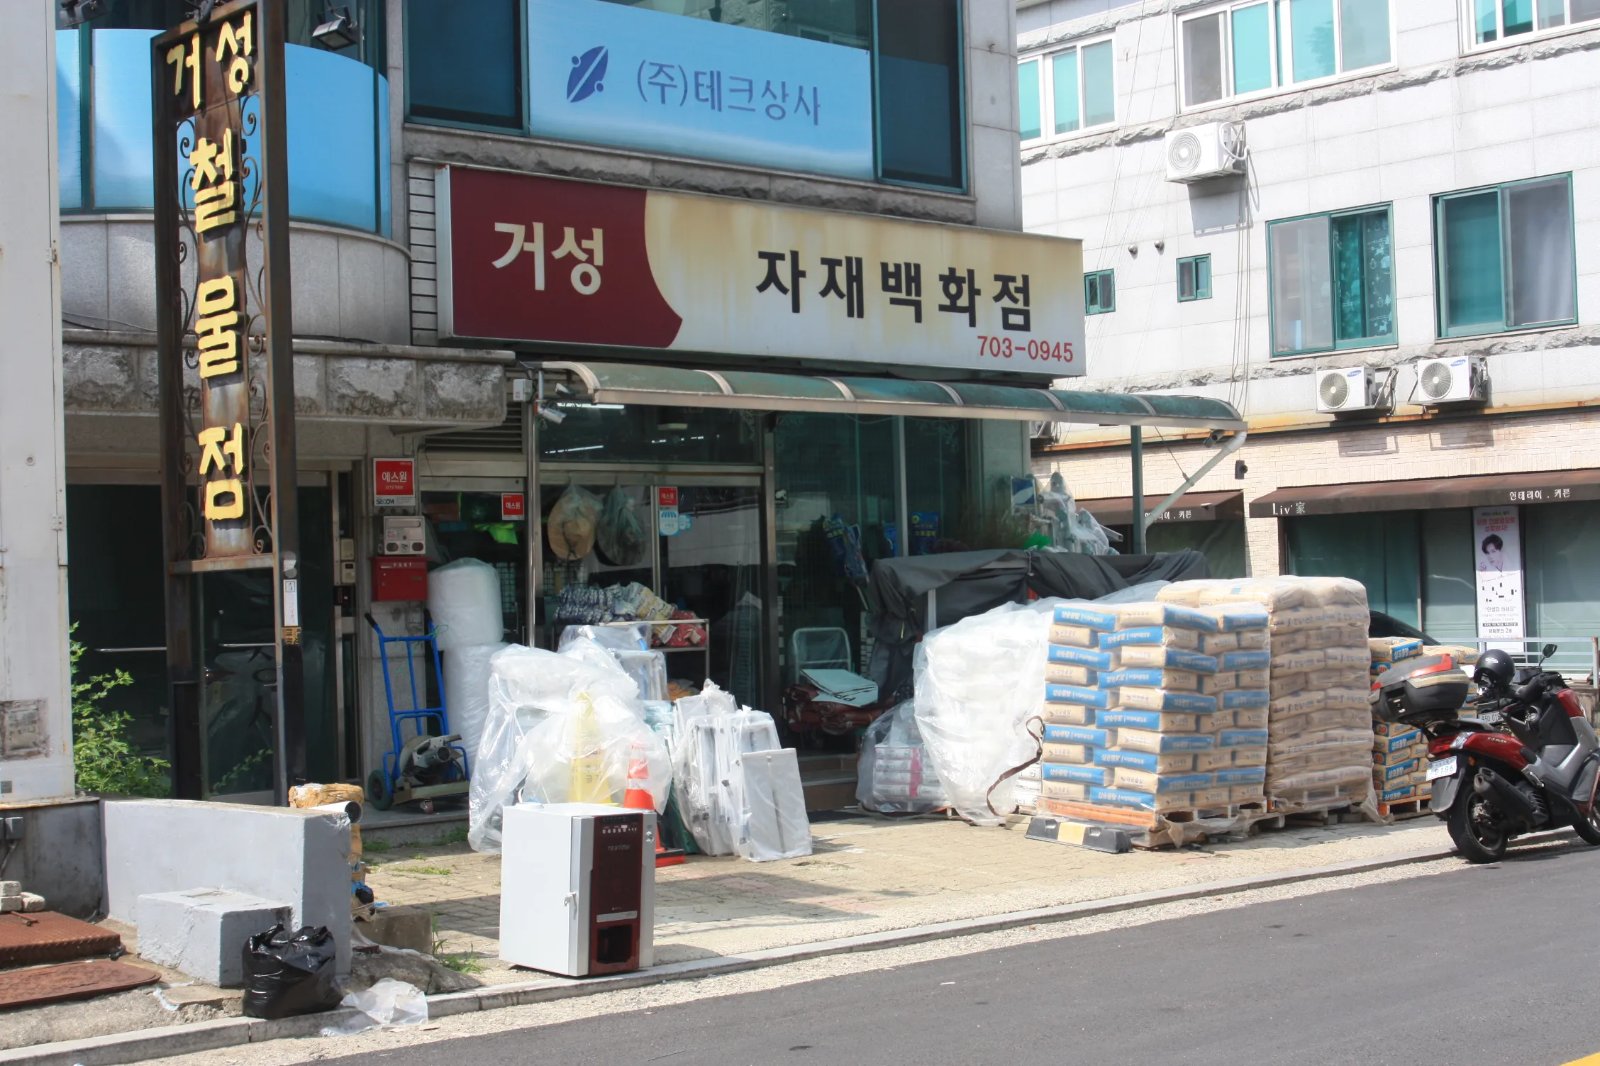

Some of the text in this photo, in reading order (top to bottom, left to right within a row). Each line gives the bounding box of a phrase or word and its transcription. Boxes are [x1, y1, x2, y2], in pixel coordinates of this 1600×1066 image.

[166, 10, 254, 109] 거성
[637, 59, 821, 127] (주)테크상사
[492, 221, 1032, 333] 거성 자재백화점
[189, 127, 245, 521] 철물점
[977, 335, 1074, 363] 703-0945
[381, 470, 408, 483] 에스원
